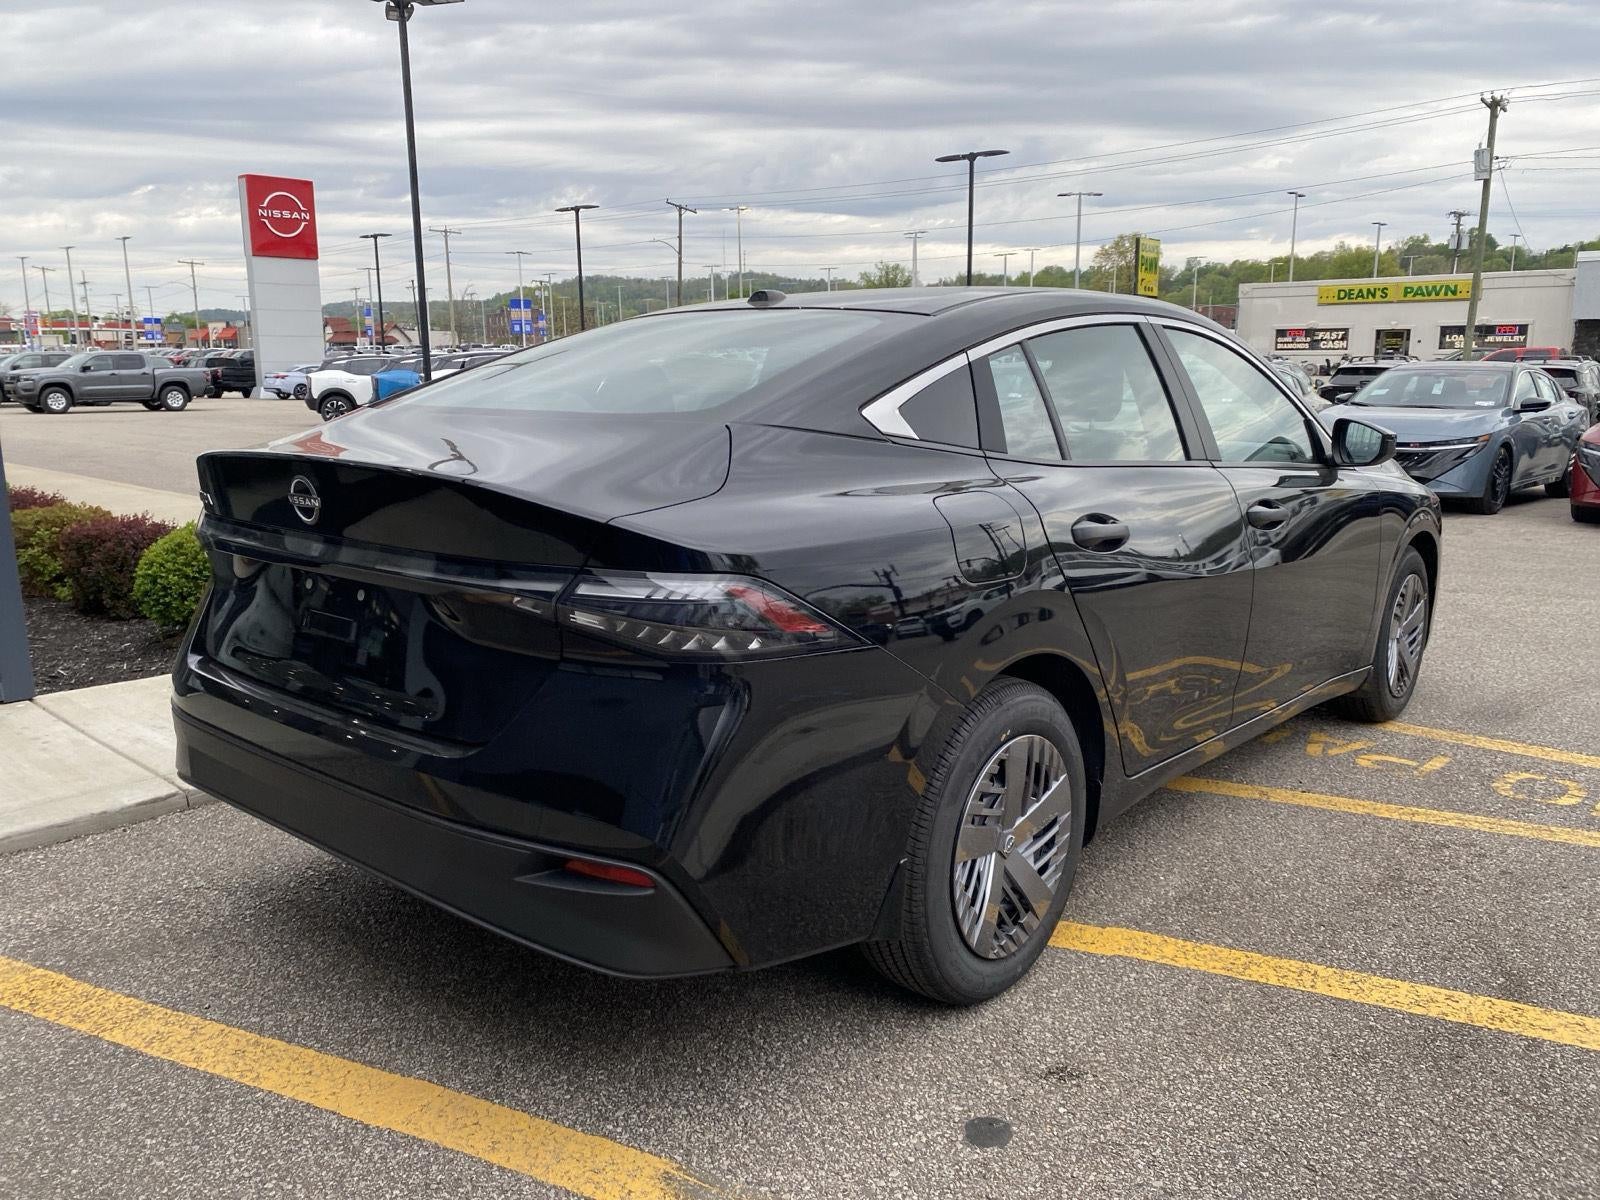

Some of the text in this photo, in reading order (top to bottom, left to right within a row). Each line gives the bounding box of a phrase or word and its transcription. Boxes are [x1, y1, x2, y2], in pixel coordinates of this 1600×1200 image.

[258, 208, 310, 220] NISSAN
[1337, 284, 1459, 300] DEAN'S PAWN
[1318, 331, 1345, 340] FAST
[1445, 334, 1465, 342] LOA
[1484, 335, 1526, 343] JEWELRY
[1320, 340, 1347, 349] CASH
